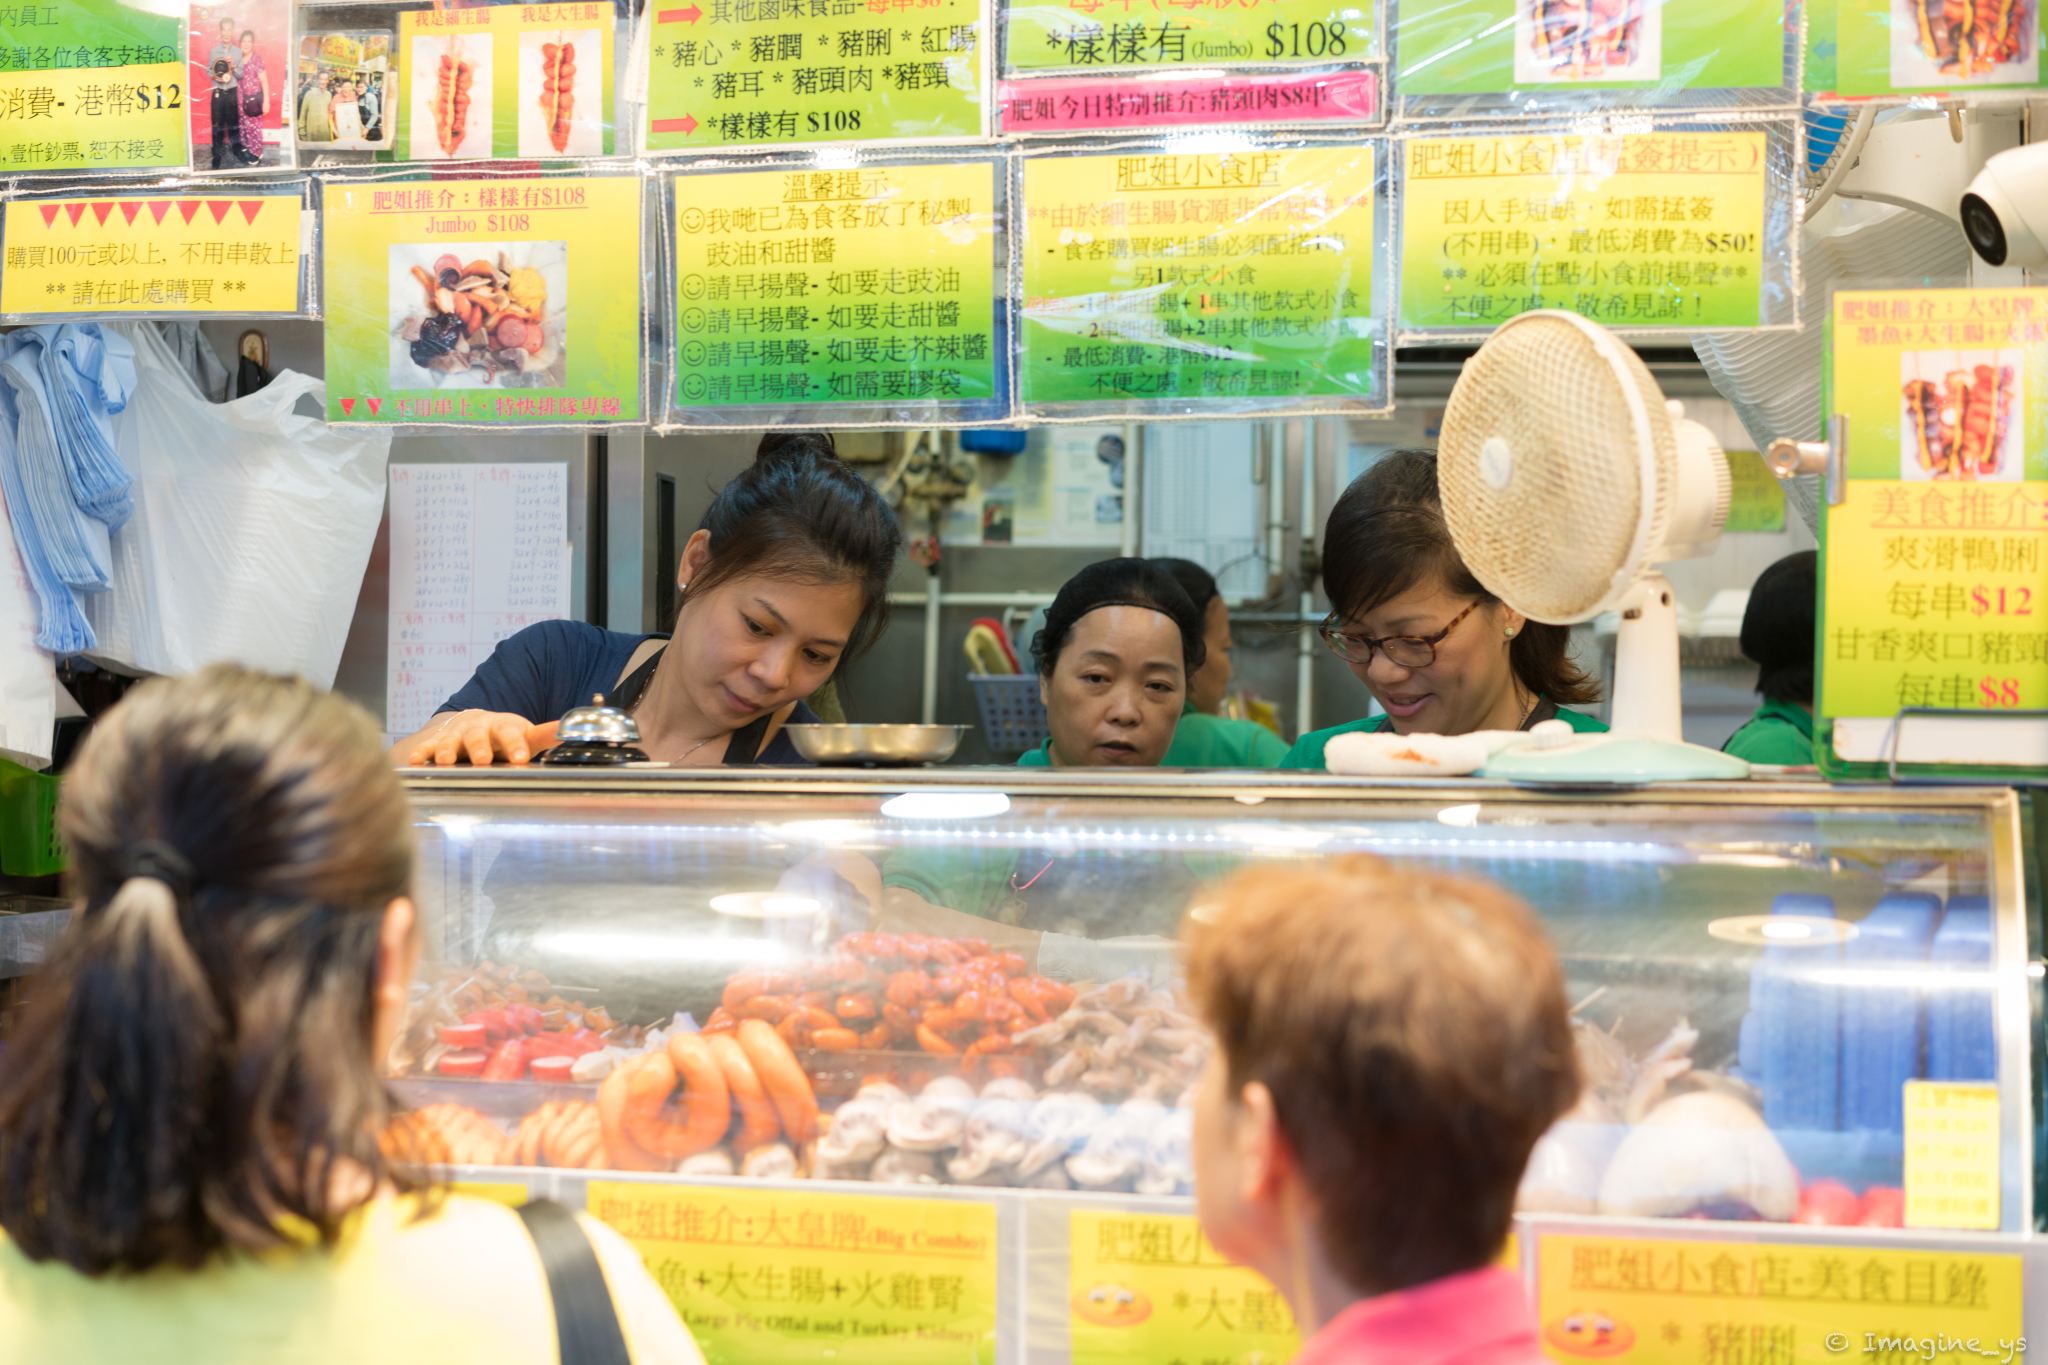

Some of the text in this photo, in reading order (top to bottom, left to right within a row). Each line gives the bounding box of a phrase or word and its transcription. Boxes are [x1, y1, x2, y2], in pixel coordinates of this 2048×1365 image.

[415, 9, 491, 27] 我是細生腸
[521, 4, 600, 24] 我是大生腸
[672, 40, 723, 68] 豬心
[921, 25, 976, 53] 紅腸
[1265, 21, 1347, 59] $108
[712, 71, 764, 99] 豬耳
[792, 66, 873, 94] 豬頭肉
[75, 82, 182, 116] 港幣$12
[806, 109, 861, 132] $108
[89, 139, 164, 160] 恕不接受
[783, 172, 889, 200] 溫馨提示
[1116, 153, 1281, 189] 肥姐小食店
[425, 213, 530, 235] Jumbo $108
[707, 197, 972, 234] 我哋已為食客放了秘製
[179, 242, 295, 265] 不用串散上
[707, 237, 837, 268] 豉油和甜醬
[72, 279, 213, 306] 請在此處購買
[826, 267, 961, 297] 如要走豉油
[827, 301, 961, 330] 如要走甜醬
[826, 333, 988, 364] 如要走芥辣醬
[827, 369, 962, 399] 如需要膠袋
[1887, 580, 2032, 620] 每串$12
[1895, 671, 2021, 711] 每串$8
